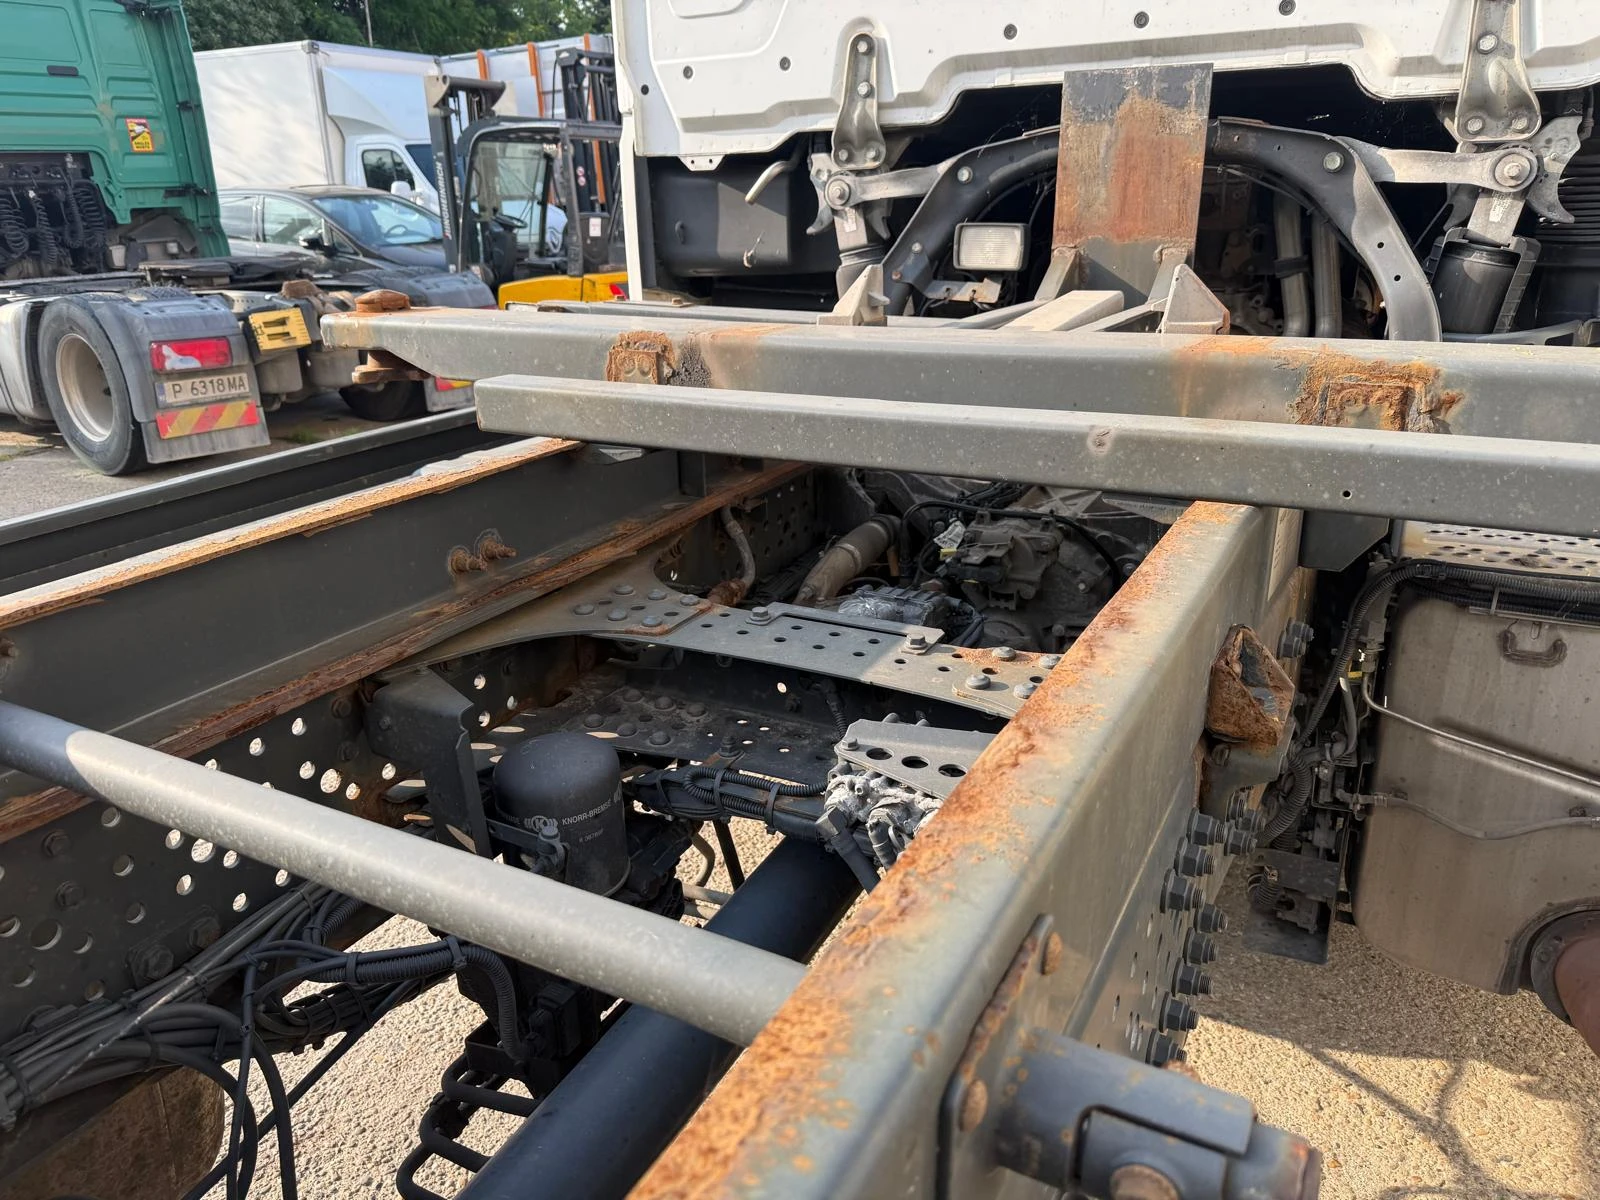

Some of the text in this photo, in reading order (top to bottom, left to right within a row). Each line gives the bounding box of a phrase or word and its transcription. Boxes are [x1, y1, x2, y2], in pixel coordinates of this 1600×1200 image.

[435, 161, 452, 240] JUNGHEINRICH
[171, 383, 183, 399] P
[561, 798, 611, 825] KNORR-BREMSE
